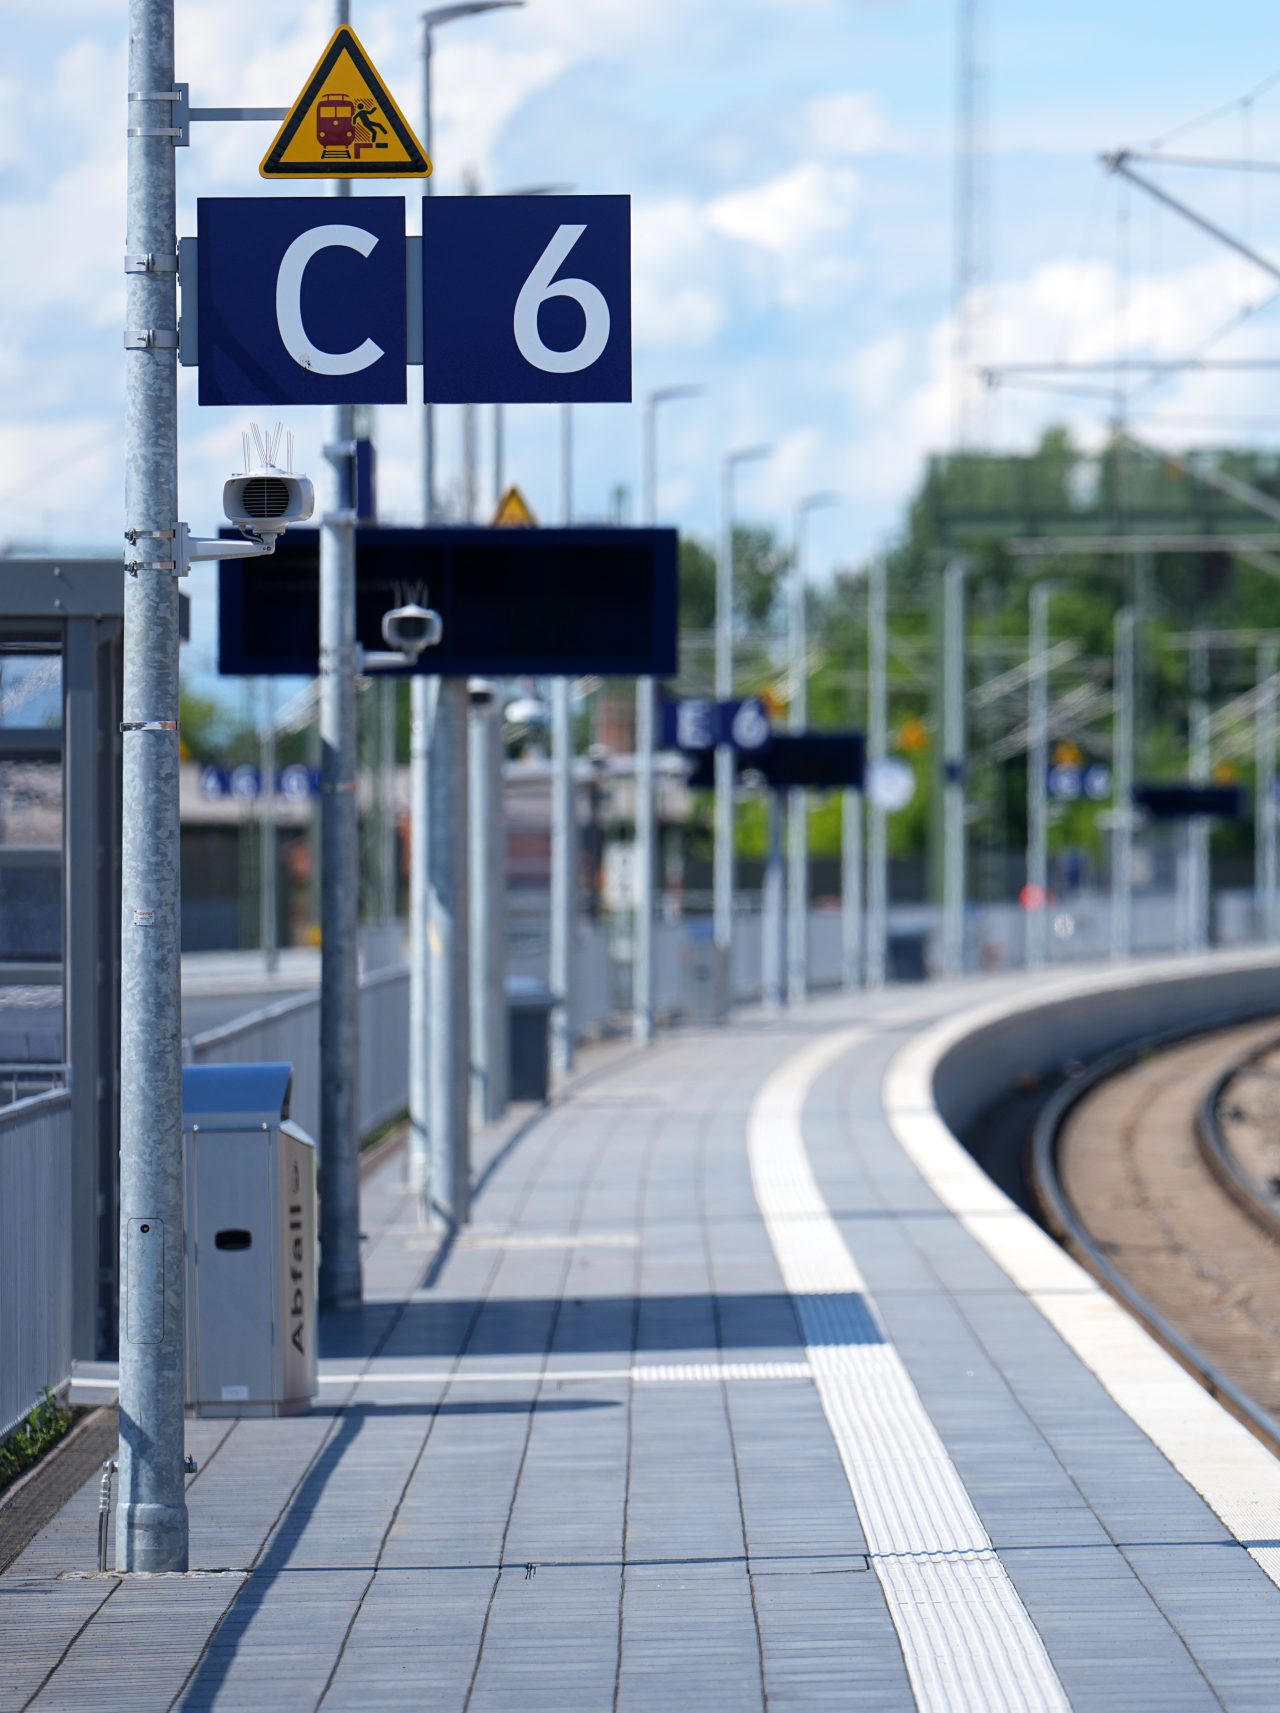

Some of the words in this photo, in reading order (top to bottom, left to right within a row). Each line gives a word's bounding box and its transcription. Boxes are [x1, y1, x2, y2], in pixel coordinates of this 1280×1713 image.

[275, 224, 385, 376] C
[513, 224, 611, 374] 6
[677, 699, 710, 748] E
[733, 699, 768, 748] 6
[289, 1204, 305, 1356] Abfall
